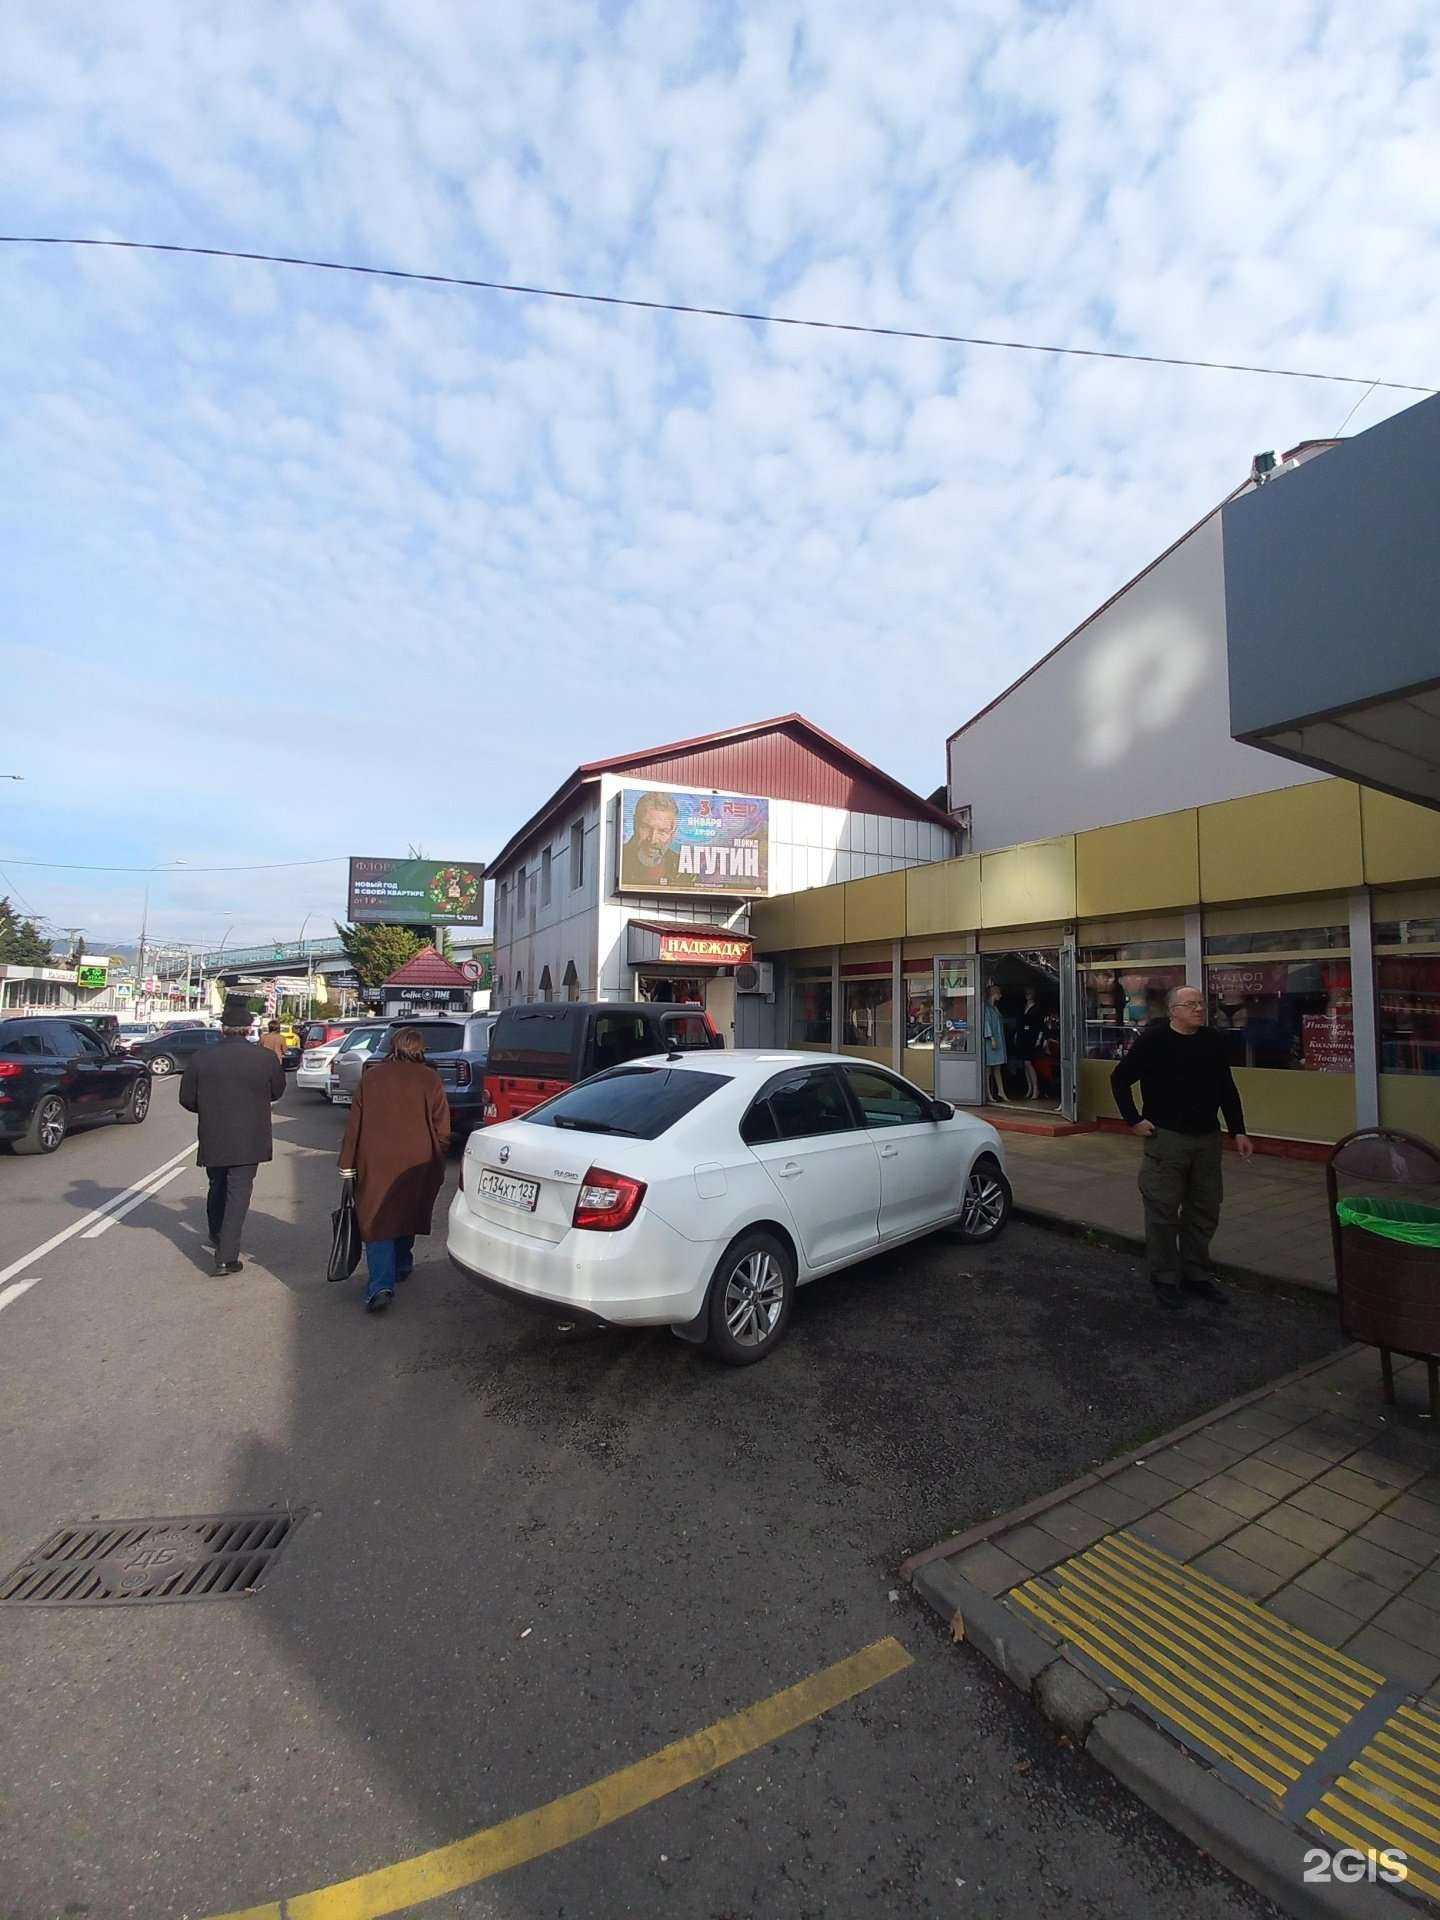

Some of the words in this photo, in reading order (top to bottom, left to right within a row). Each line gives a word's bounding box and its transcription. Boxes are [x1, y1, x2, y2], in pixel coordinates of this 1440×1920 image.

[700, 800, 712, 818] 3
[677, 845, 760, 878] АГУТИН
[354, 880, 383, 889] НОВЫЙ
[383, 882, 399, 890] ГОД
[361, 888, 387, 896] СВОЕЙ
[386, 890, 425, 898] КВАРТИРЕ
[401, 990, 421, 999] Coffee
[434, 990, 450, 998] TIME
[518, 1183, 535, 1199] 123
